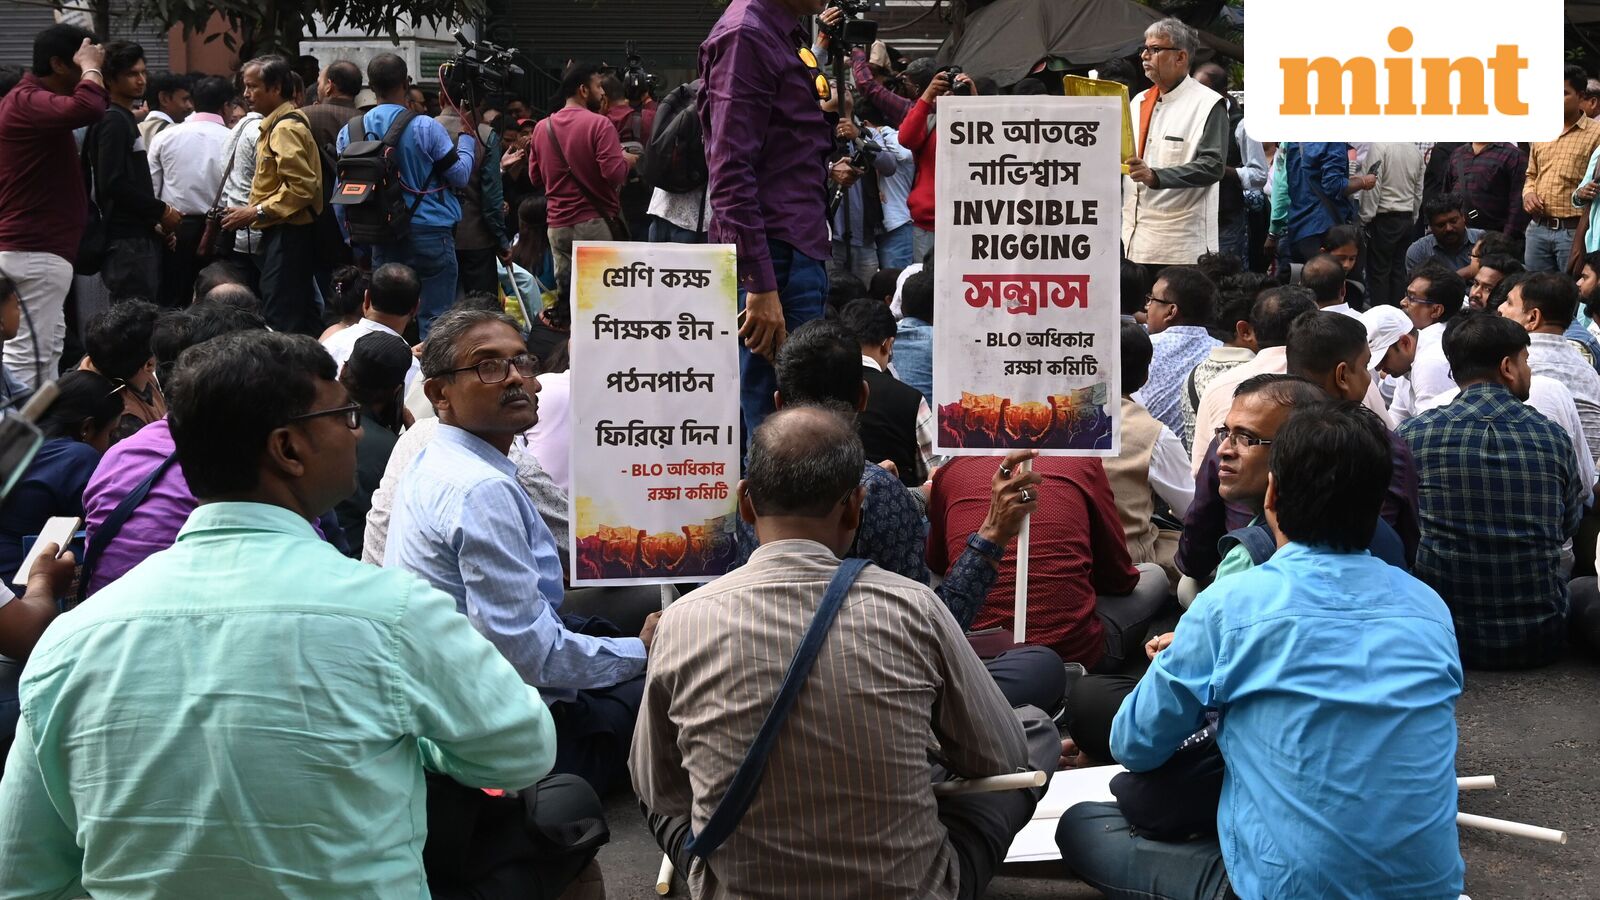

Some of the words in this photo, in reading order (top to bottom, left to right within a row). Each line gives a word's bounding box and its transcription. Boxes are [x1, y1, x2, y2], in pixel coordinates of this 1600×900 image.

[950, 121, 995, 145] SIR
[1001, 118, 1100, 147] আতঙ্কে
[968, 153, 1081, 187] নাভিশ্বাস
[953, 199, 1098, 226] INVISIBLE
[971, 233, 1091, 261] RIGGING
[602, 261, 655, 288] শ্রেণি
[659, 268, 712, 289] কক্ষ
[962, 273, 1090, 316] সন্ত্রাস
[592, 313, 673, 340] শিক্ষক
[676, 312, 715, 341] হীন
[986, 332, 1022, 347] BLO
[1026, 327, 1095, 349] অধিকার
[1003, 358, 1043, 376] রক্ষা
[1045, 354, 1098, 376] কমিটি
[606, 366, 715, 393] পঠনপাঠন
[594, 419, 676, 450] ফিরিয়ে
[679, 418, 720, 446] দিন
[631, 463, 663, 477] BLO
[666, 458, 726, 476] অধিকার
[647, 485, 682, 502] রক্ষা
[684, 481, 729, 501] কমিটি
